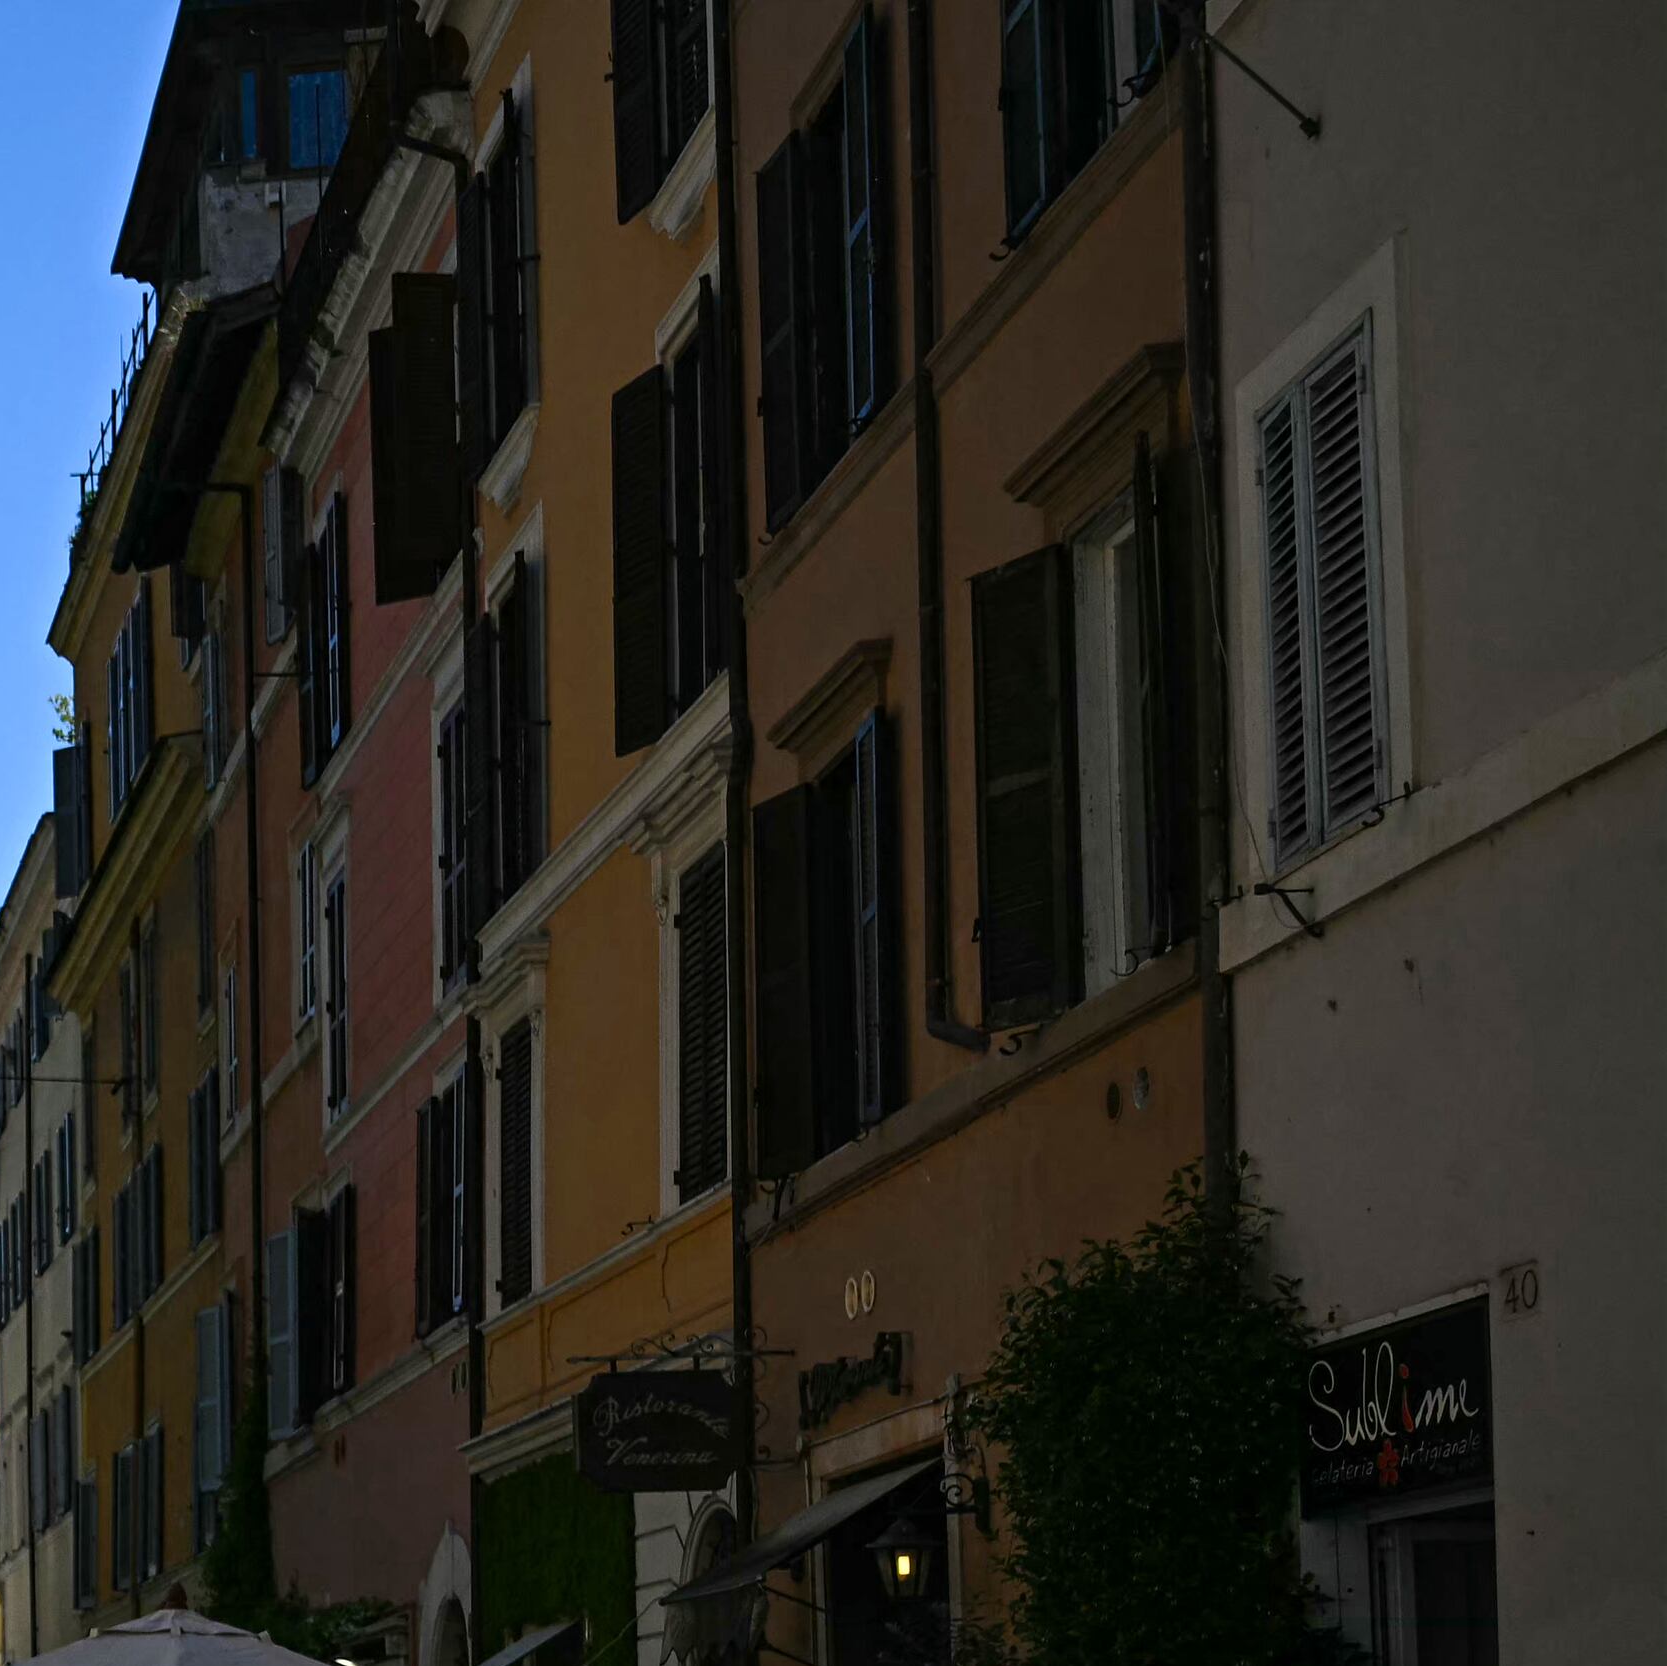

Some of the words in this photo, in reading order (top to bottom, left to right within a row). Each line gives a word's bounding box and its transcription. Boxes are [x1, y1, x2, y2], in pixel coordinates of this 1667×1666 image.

[1504, 1269, 1538, 1313] 40
[592, 1392, 731, 1440] Ristorante
[1307, 1340, 1480, 1452] Sublime
[1400, 1427, 1483, 1471] Artigianale
